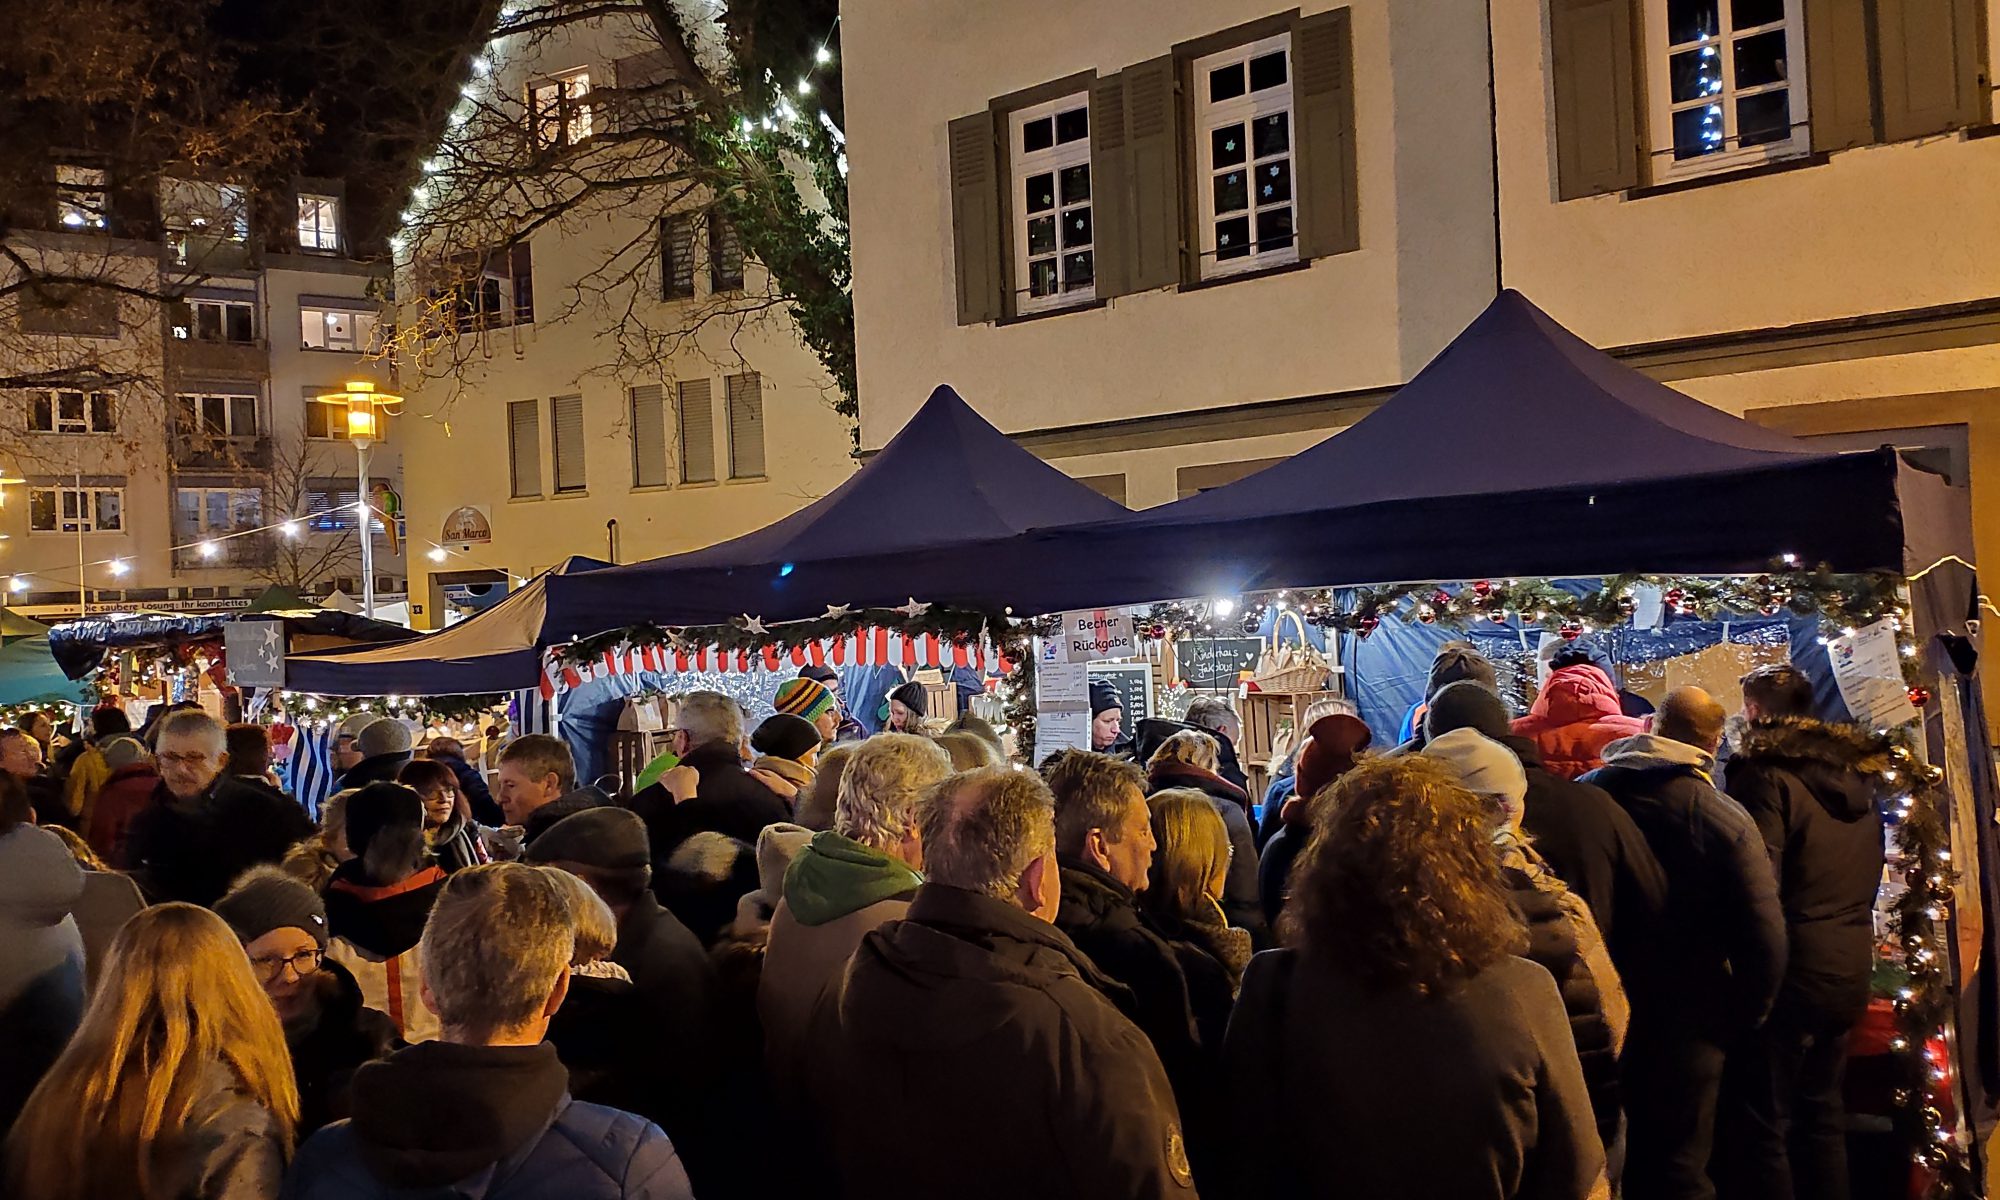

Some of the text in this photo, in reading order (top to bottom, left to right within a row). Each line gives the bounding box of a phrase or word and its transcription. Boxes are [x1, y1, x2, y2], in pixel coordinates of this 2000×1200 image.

[446, 529, 487, 541] San Marco
[99, 602, 138, 612] saubere
[181, 600, 194, 609] Ihr
[197, 600, 249, 609] komplettes
[1078, 617, 1119, 630] Becher
[1073, 636, 1128, 652] Rückgabe
